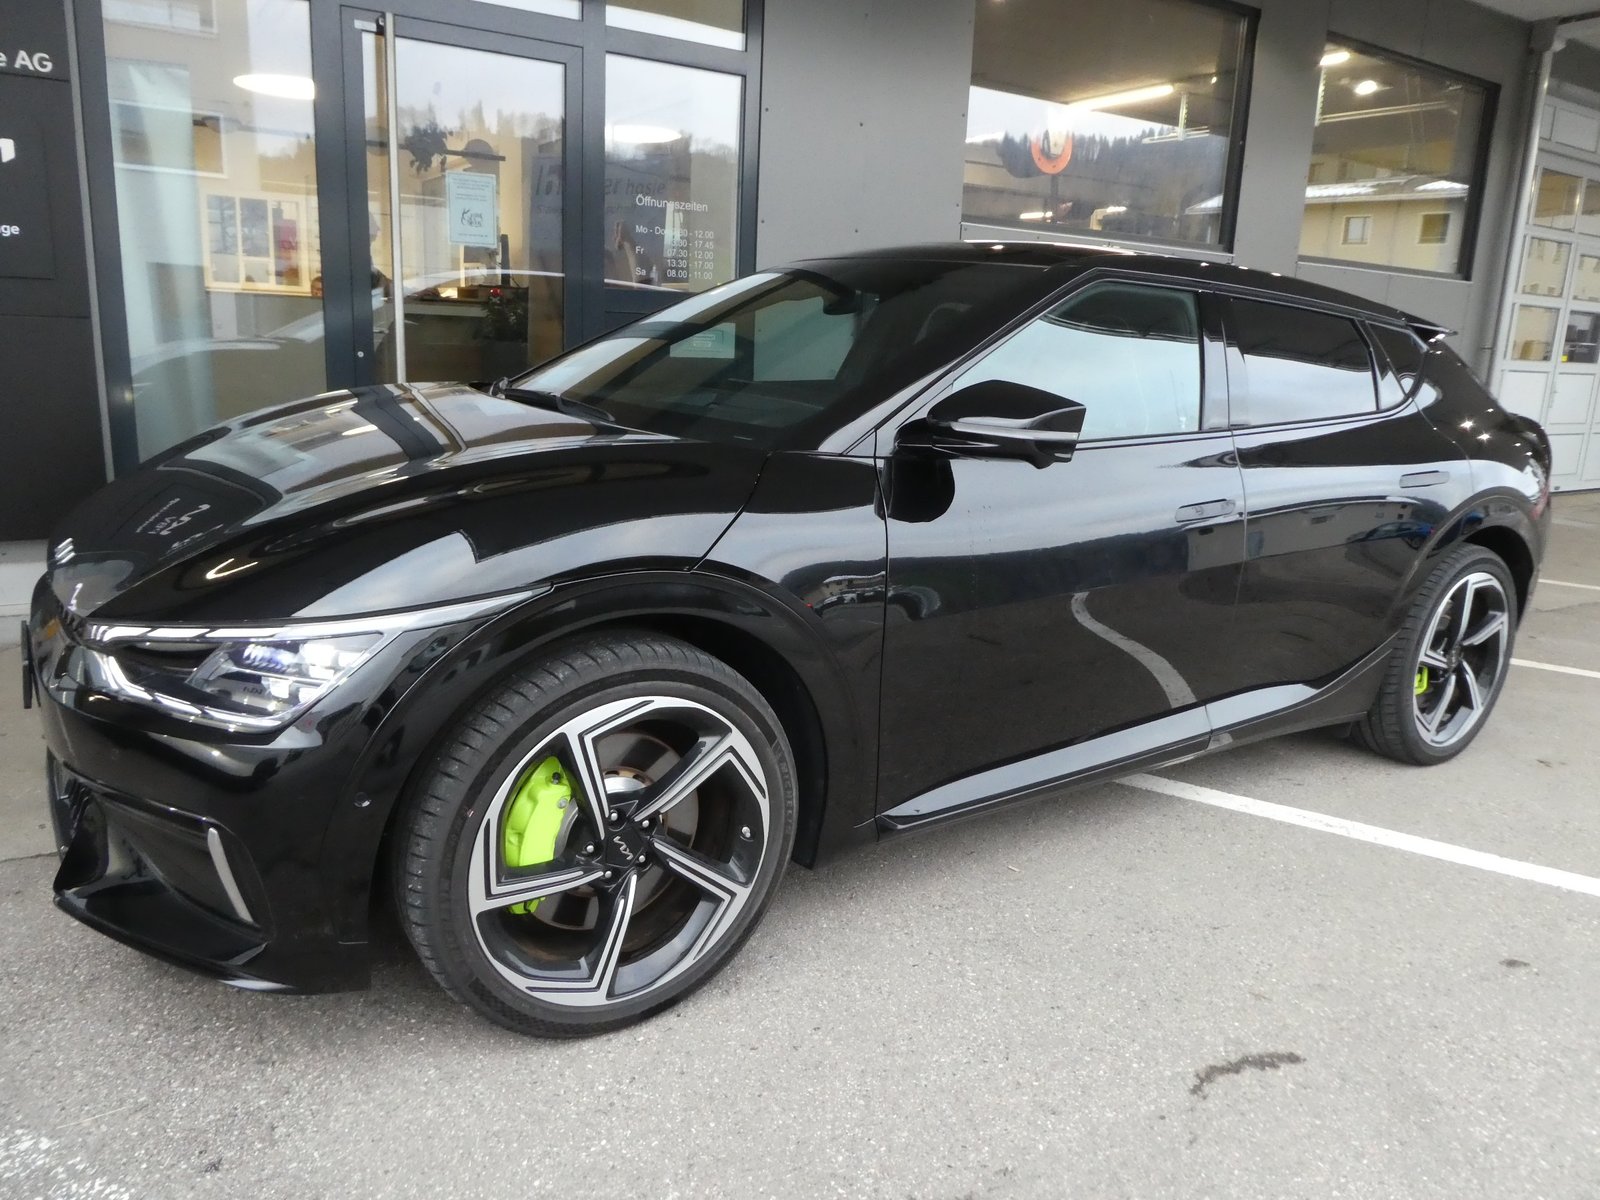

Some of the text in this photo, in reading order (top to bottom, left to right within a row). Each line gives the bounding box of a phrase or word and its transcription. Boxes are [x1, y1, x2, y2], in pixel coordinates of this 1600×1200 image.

[14, 50, 53, 73] AG
[0, 224, 20, 237] ge
[636, 225, 648, 233] Mo
[654, 226, 666, 235] Do
[694, 230, 714, 239] 12.00
[667, 239, 688, 247] 3.30
[694, 240, 714, 249] 17.45
[635, 246, 644, 254] Fr
[667, 249, 688, 258] 07.30
[694, 251, 714, 259] 12.00
[667, 259, 687, 268] 13.30
[694, 261, 714, 270] 17.00
[635, 267, 646, 276] Sa
[667, 269, 688, 278] 08.00
[694, 271, 713, 280] 11.00
